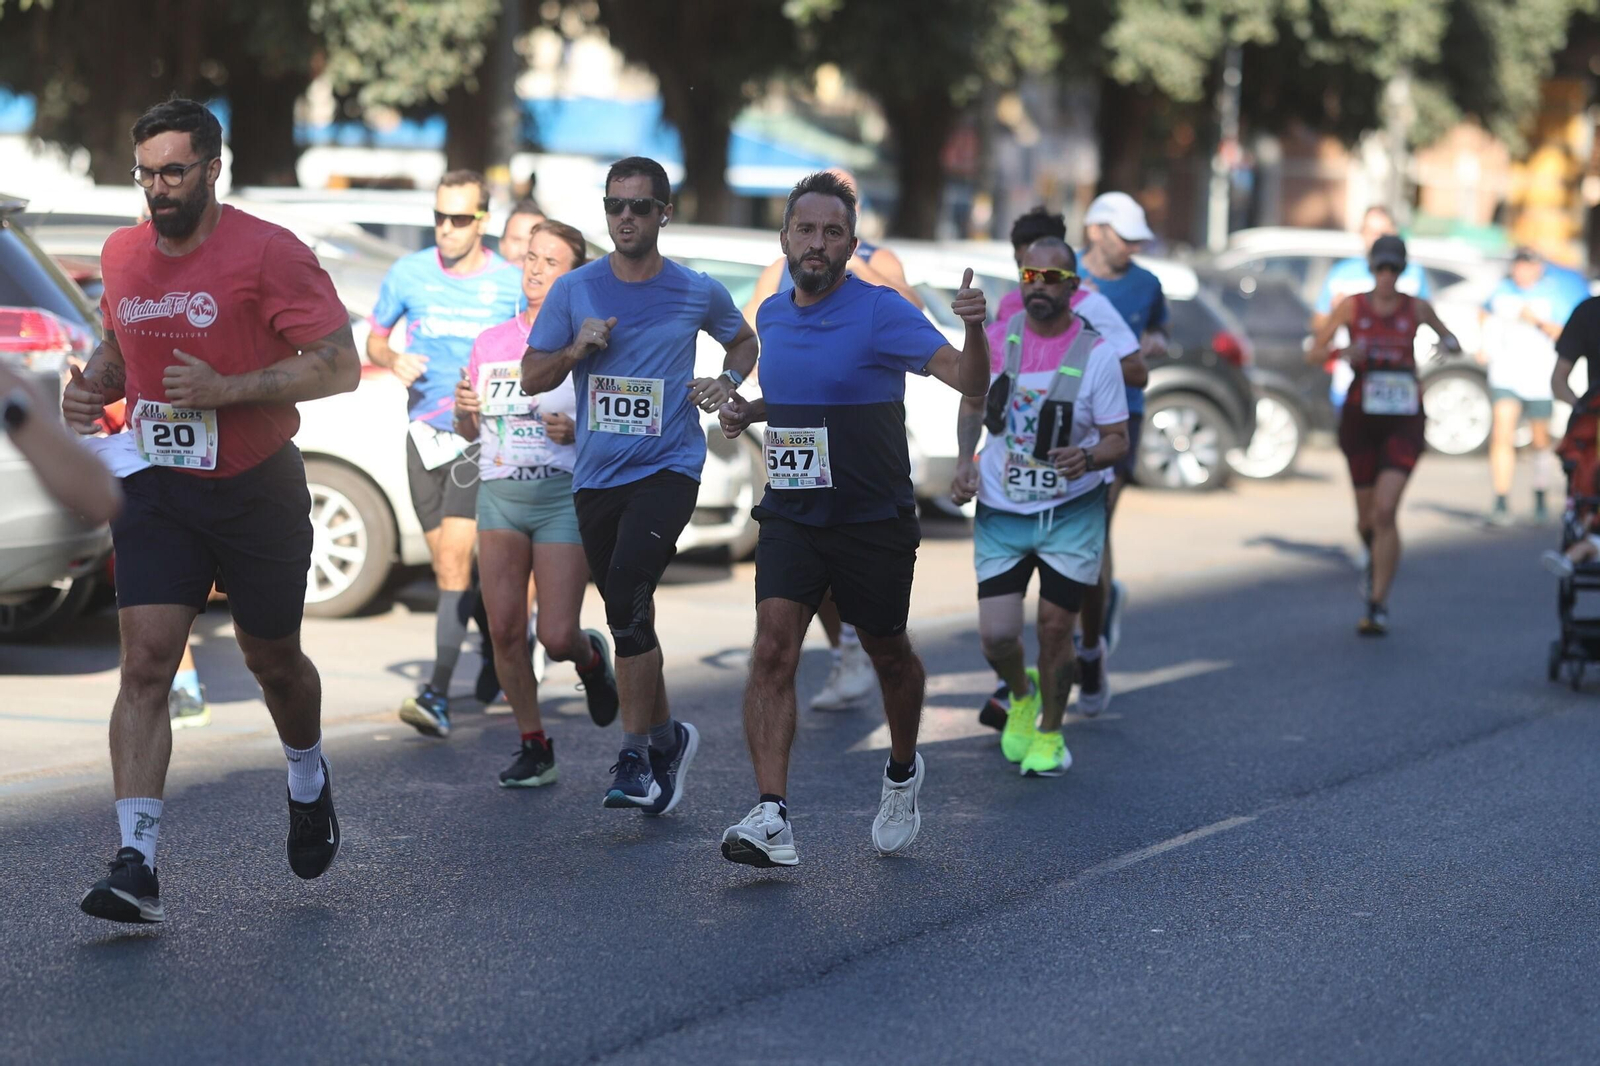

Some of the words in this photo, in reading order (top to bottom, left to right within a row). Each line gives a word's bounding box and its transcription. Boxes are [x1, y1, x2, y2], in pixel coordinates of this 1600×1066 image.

[626, 385, 652, 393] 2025
[172, 411, 203, 420] 2025
[598, 396, 650, 418] 108
[152, 424, 195, 447] 20
[767, 449, 814, 470] 547
[1008, 467, 1057, 488] 219
